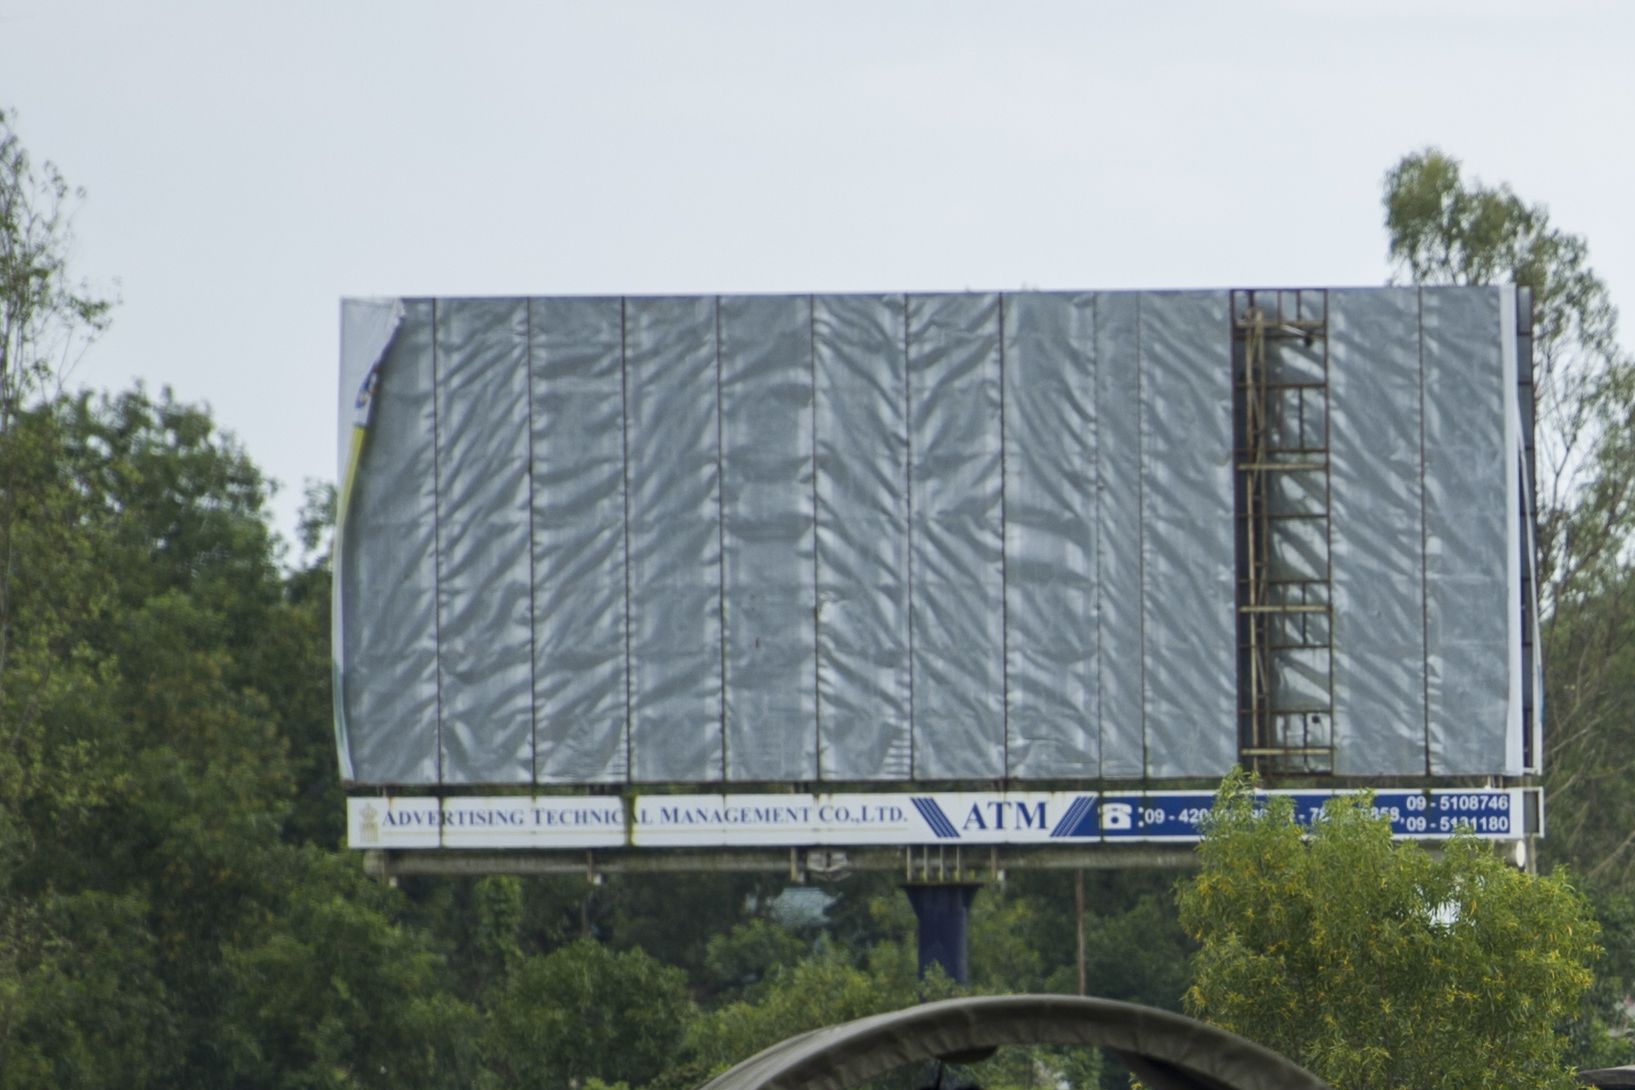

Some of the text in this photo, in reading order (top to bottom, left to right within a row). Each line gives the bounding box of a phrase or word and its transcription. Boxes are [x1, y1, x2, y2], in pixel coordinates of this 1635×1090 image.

[1406, 795, 1427, 812] 09
[1439, 794, 1509, 812] 5108746
[963, 801, 1048, 830] ATM
[1406, 816, 1427, 832] 09
